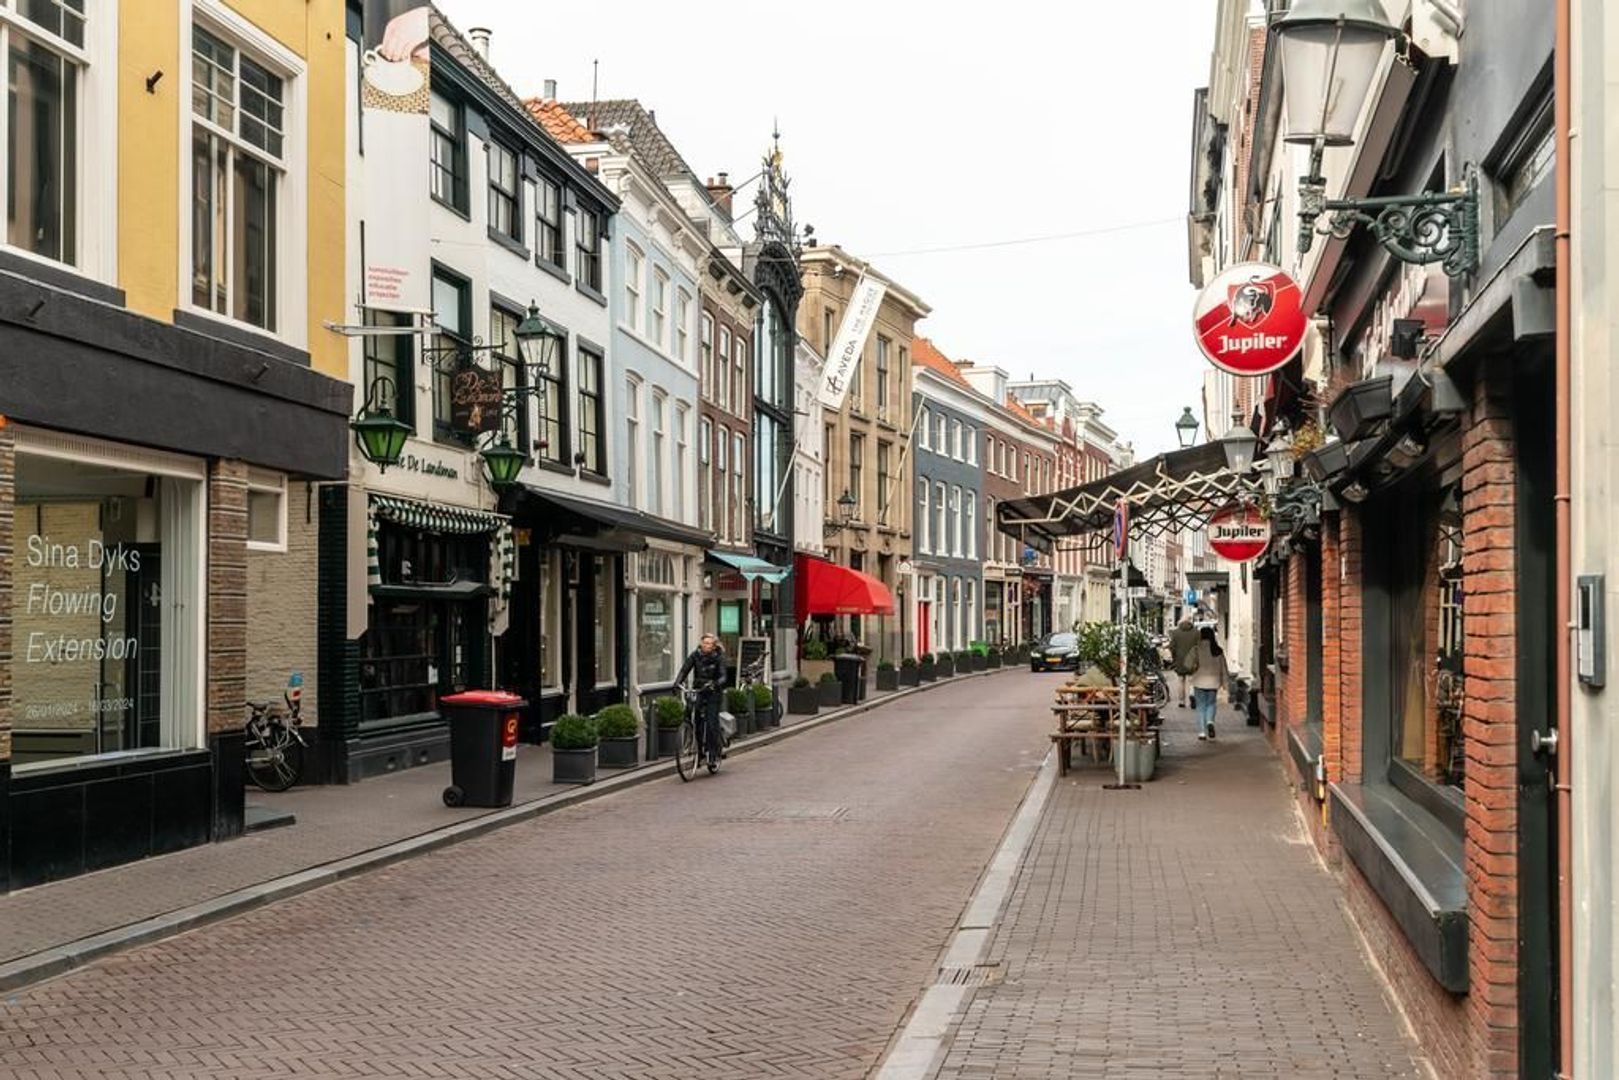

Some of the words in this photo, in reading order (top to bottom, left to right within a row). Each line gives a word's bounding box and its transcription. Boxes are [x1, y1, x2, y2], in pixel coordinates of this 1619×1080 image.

[837, 339, 858, 376] AVEDA
[1216, 332, 1288, 355] Jupiler
[407, 454, 419, 472] De
[1213, 525, 1265, 539] Jupiler
[27, 534, 79, 569] Sina
[88, 539, 140, 577] Dyks
[26, 583, 117, 623] Flowing
[26, 632, 138, 663] Extension
